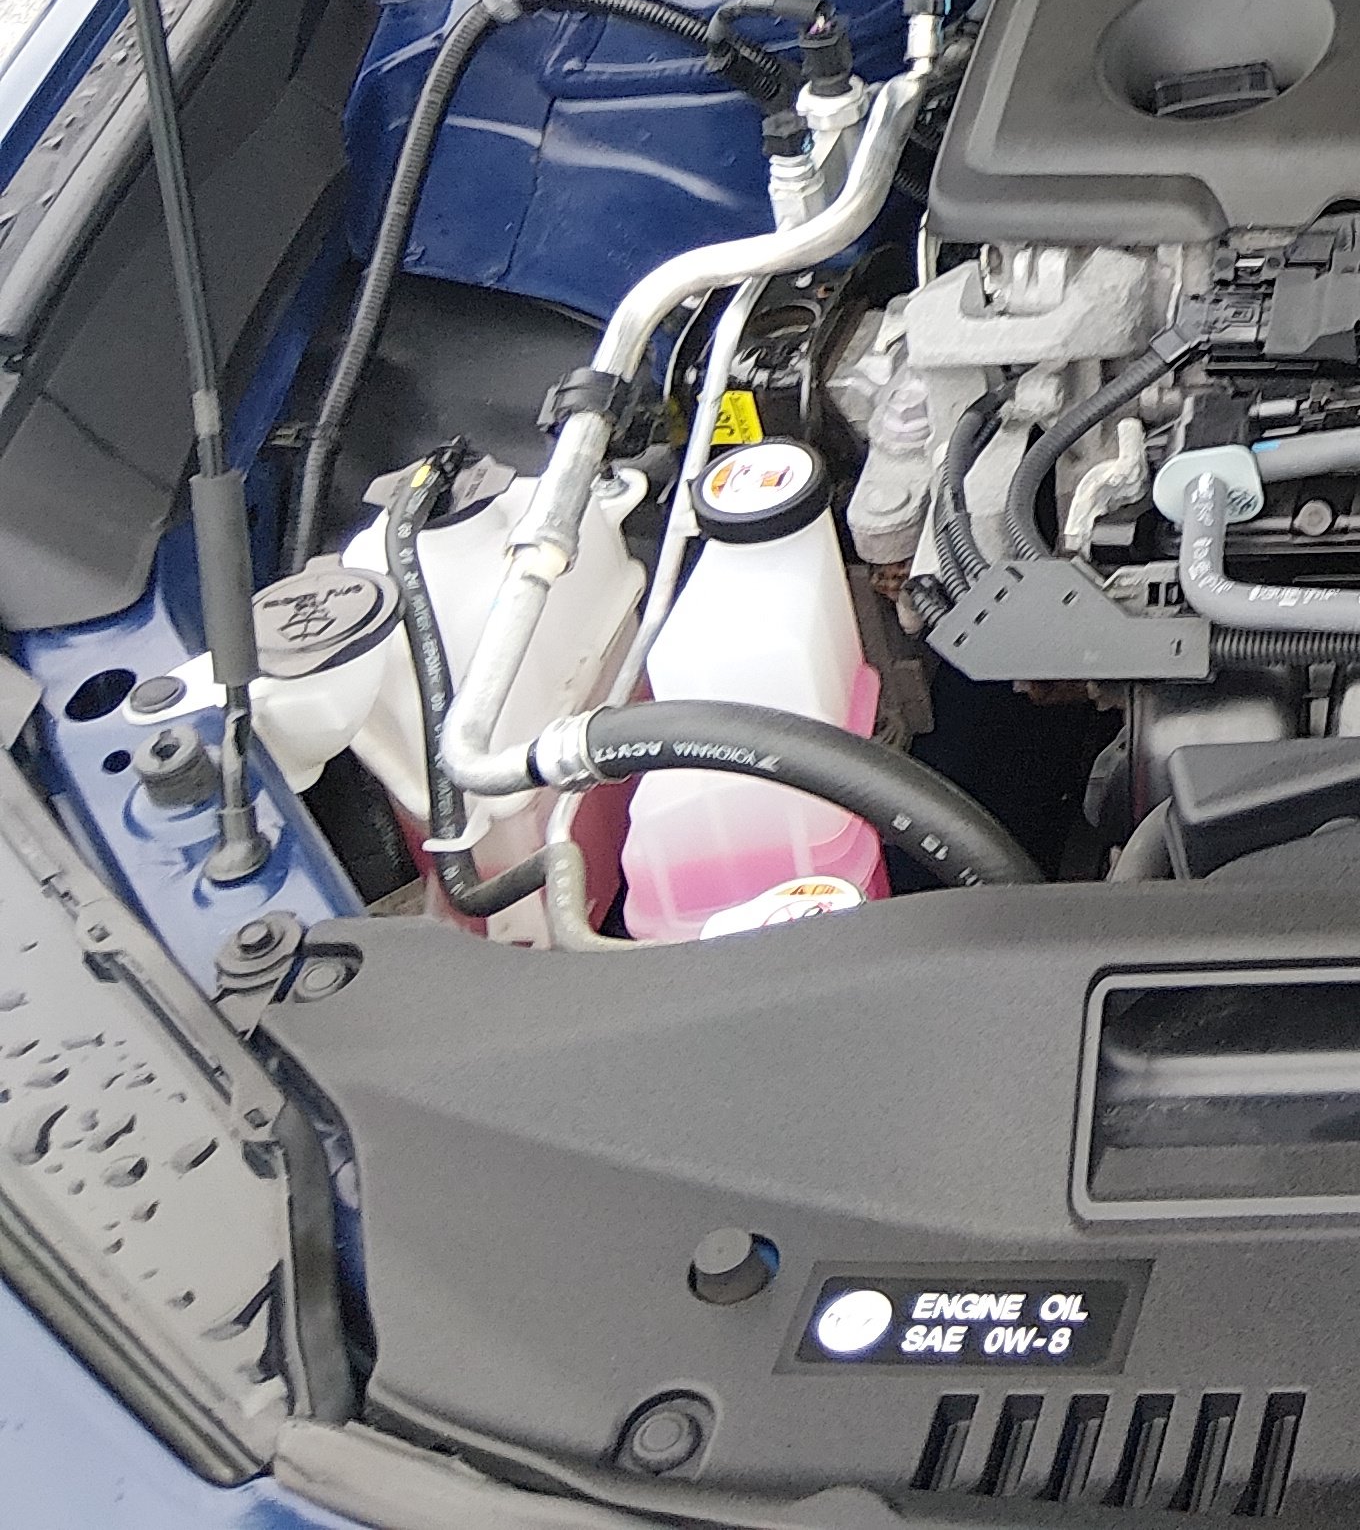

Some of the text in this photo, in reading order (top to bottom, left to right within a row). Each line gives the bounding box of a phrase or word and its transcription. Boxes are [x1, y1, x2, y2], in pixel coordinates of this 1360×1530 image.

[672, 740, 756, 767] YOKOHAMA
[911, 1292, 1089, 1321] ENGINE OIL
[901, 1325, 1073, 1354] SAE 0W-8
